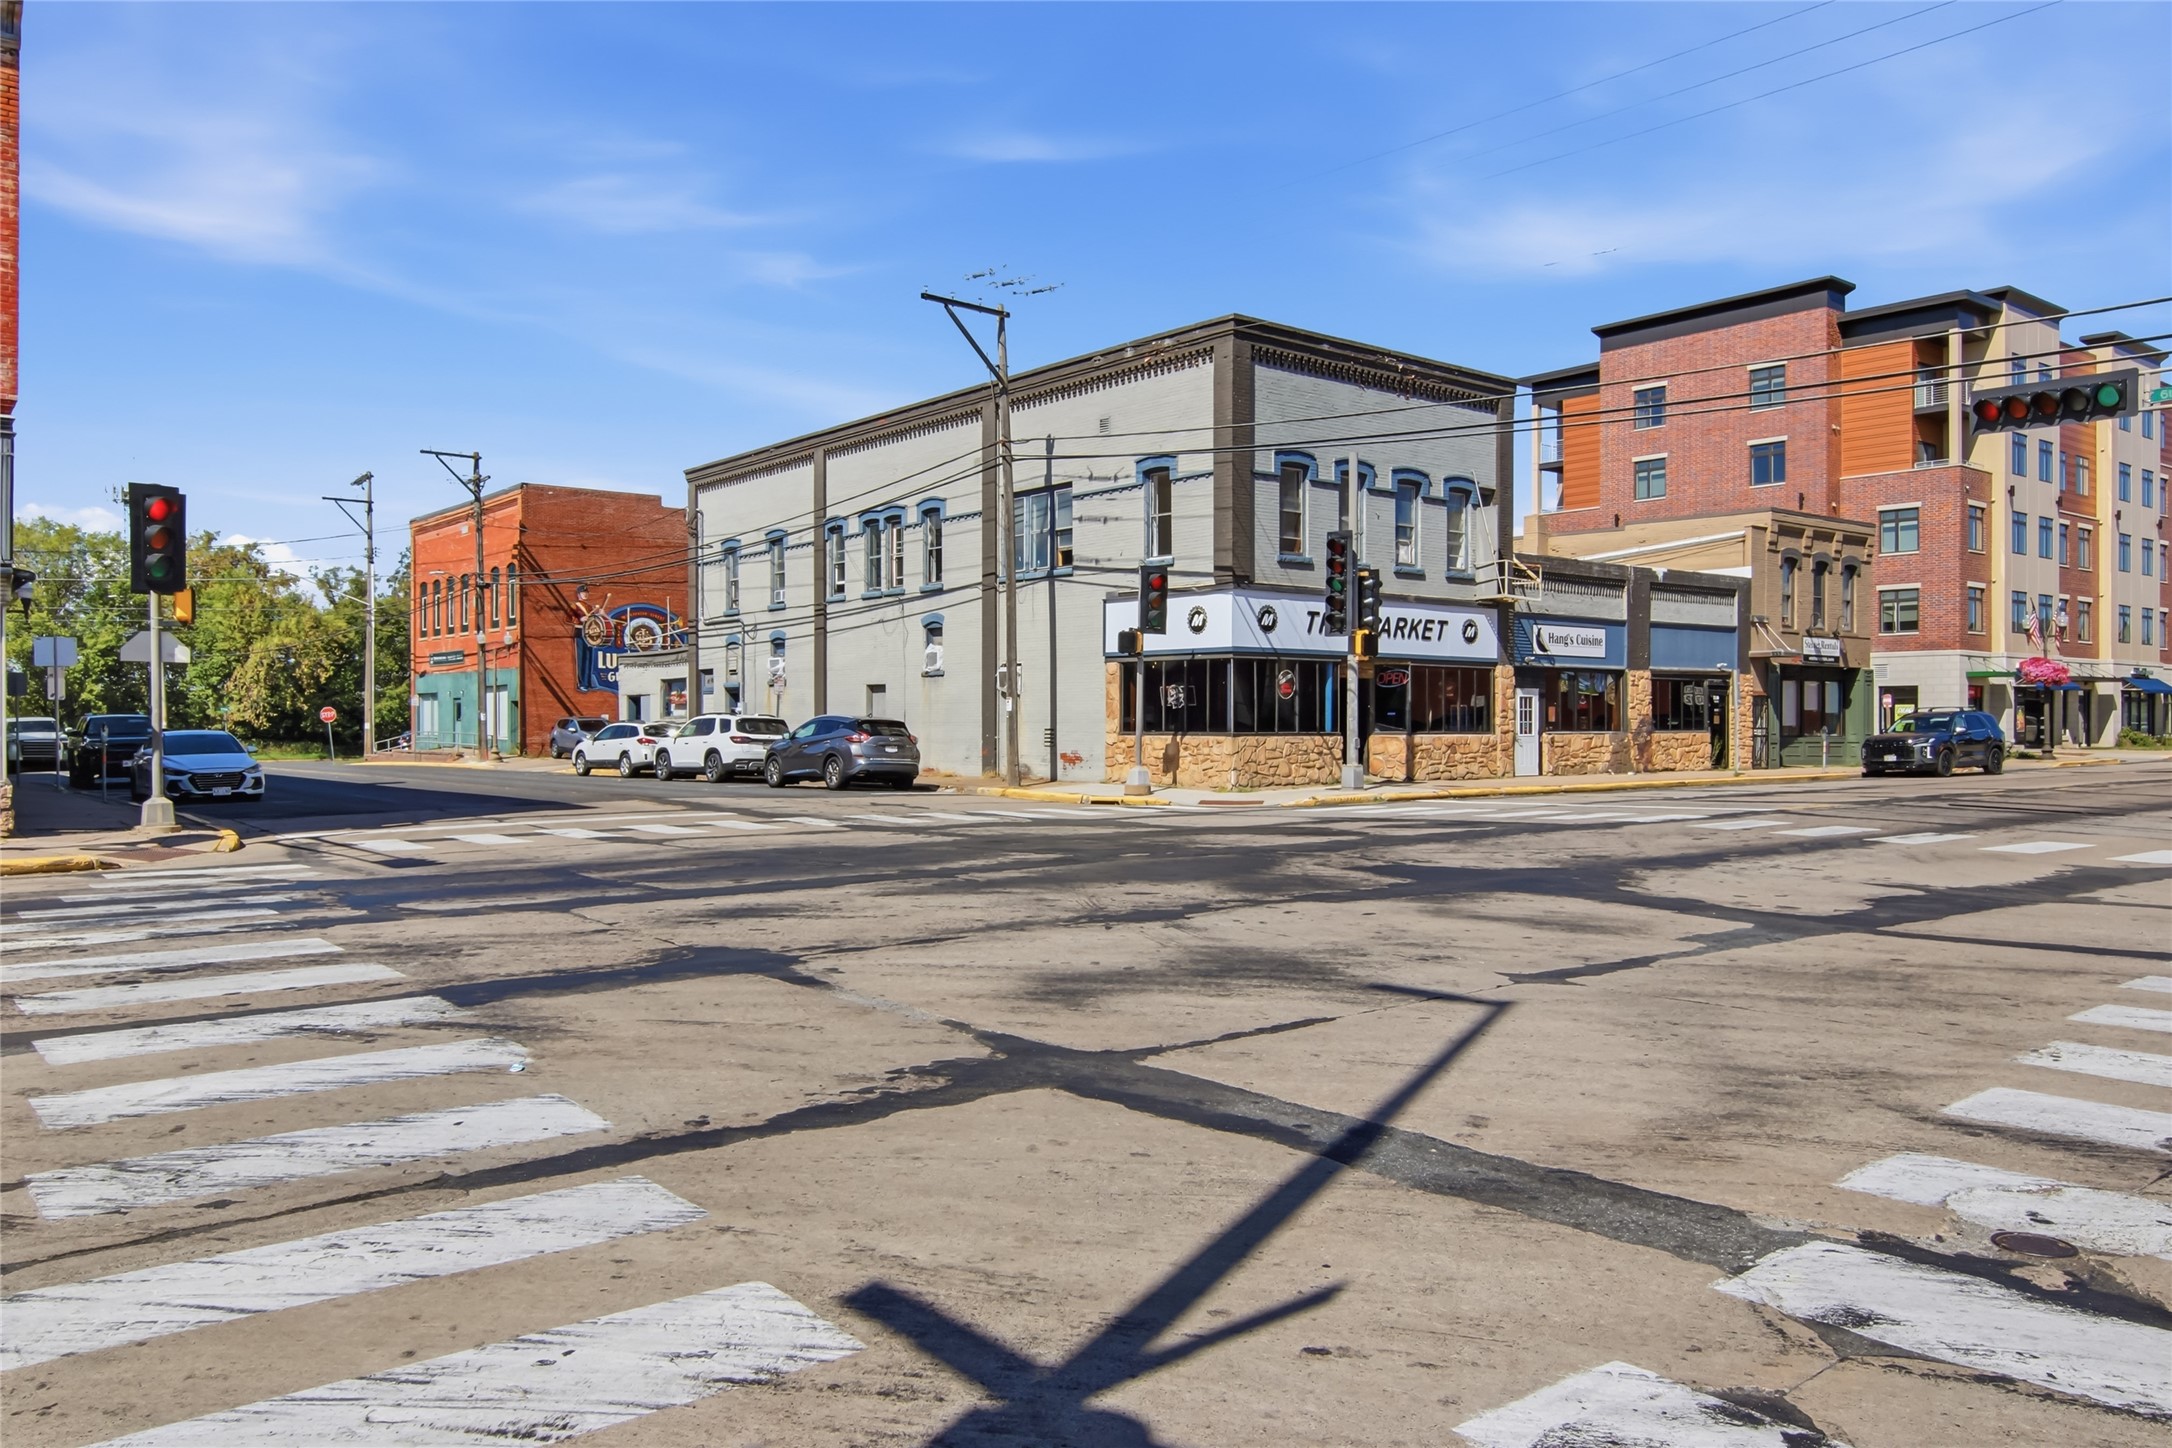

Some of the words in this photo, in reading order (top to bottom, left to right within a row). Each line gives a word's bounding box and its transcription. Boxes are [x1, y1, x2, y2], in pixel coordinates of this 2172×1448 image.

[1191, 613, 1204, 627] M
[1260, 613, 1274, 626] M
[1378, 616, 1449, 641] ARKET
[1464, 626, 1475, 638] M
[1548, 632, 1574, 647] Hang's
[1576, 633, 1603, 647] Cuisine
[1377, 672, 1407, 685] OPEN
